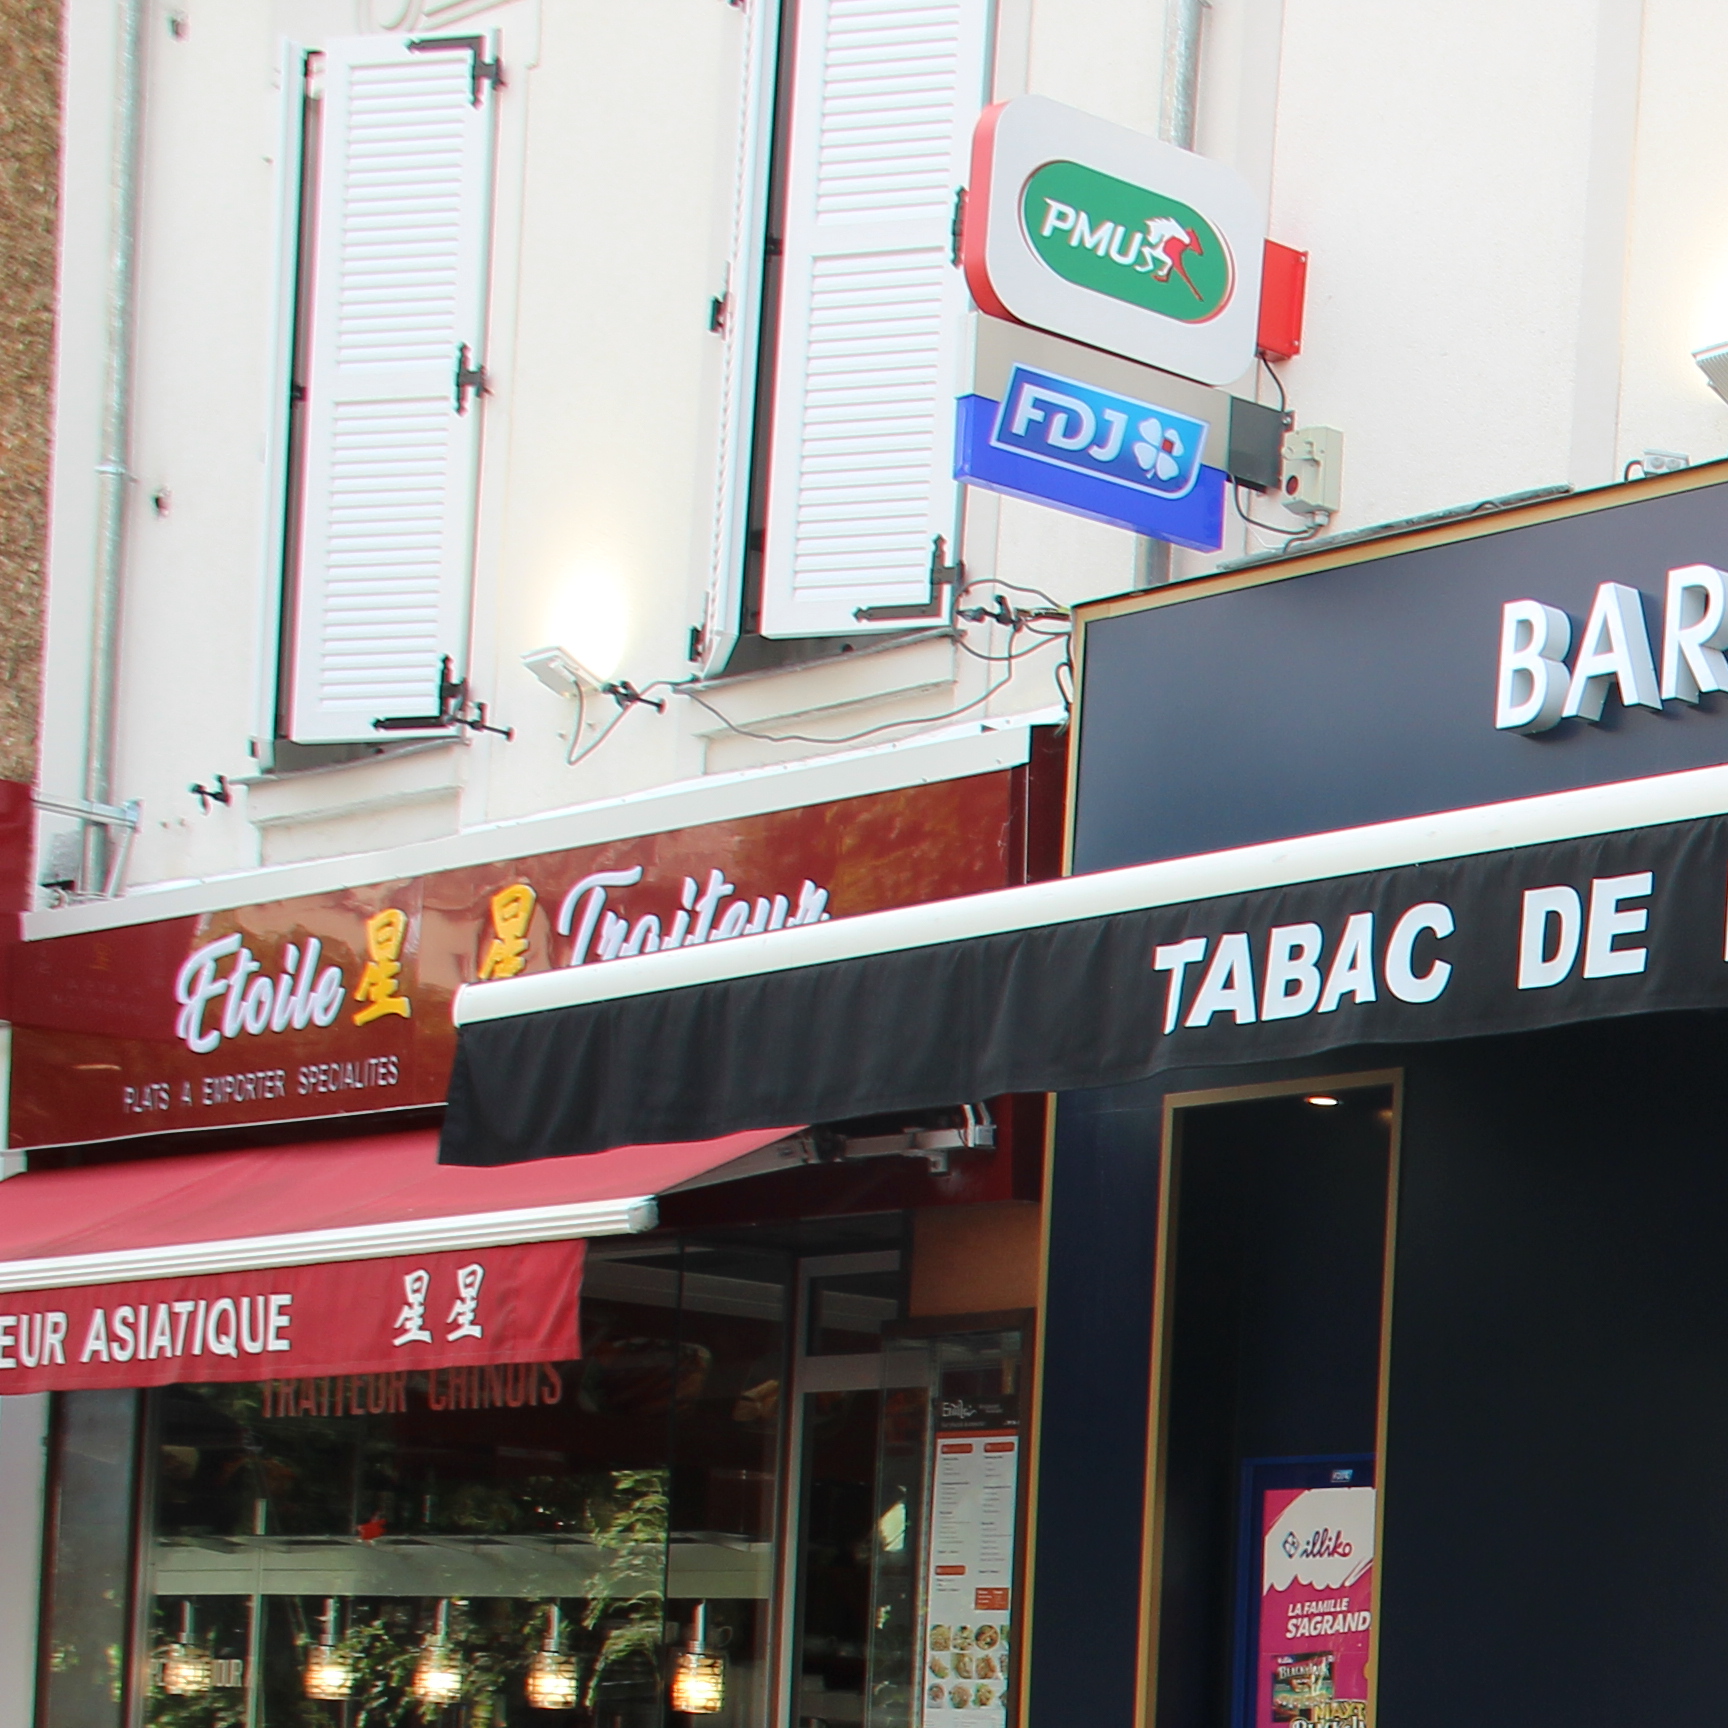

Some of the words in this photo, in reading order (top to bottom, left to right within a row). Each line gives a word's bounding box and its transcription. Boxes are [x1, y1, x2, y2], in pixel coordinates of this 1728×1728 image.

[1042, 196, 1143, 268] PMU
[1011, 382, 1129, 464] FDJ
[352, 908, 411, 1026] 星
[478, 884, 537, 978] 星
[1155, 901, 1454, 1036] TABAC
[1518, 871, 1651, 989] DE
[176, 932, 346, 1053] Etoile
[123, 1082, 170, 1113] PLATS
[181, 1081, 194, 1107] A
[203, 1069, 286, 1106] EMPORTER
[298, 1056, 399, 1095] SPECIALITES
[0, 1311, 67, 1369] EUR
[79, 1292, 293, 1364] ASIATIQUE
[261, 1363, 407, 1418] TRAITEUR
[428, 1359, 562, 1410] CHINOIS
[1300, 1528, 1352, 1559] illiko
[1286, 1611, 1371, 1639] S'AGRAND
[1288, 1604, 1301, 1616] LA
[1303, 1598, 1349, 1615] FAMILLE
